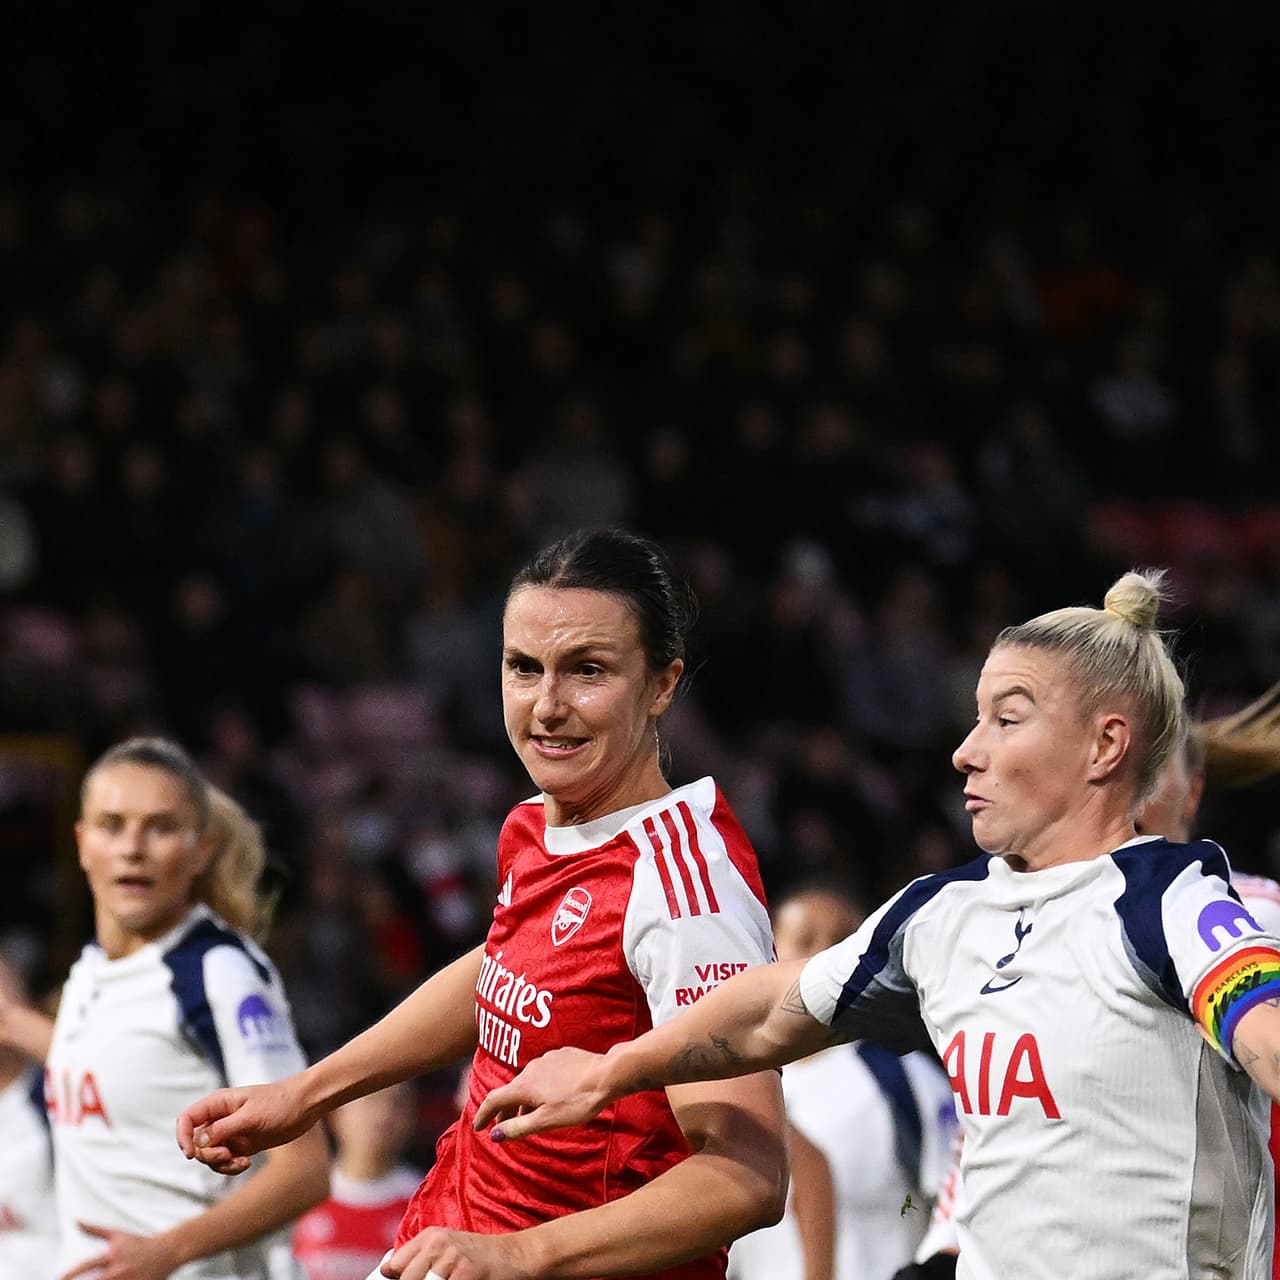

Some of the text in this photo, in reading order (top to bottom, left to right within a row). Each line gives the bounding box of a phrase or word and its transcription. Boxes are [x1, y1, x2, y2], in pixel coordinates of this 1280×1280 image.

[475, 950, 554, 1028] mirates
[694, 962, 749, 983] VISIT
[1215, 961, 1260, 994] BARCLAYS
[478, 1006, 522, 1068] BETTER
[942, 1029, 1062, 1120] AIA
